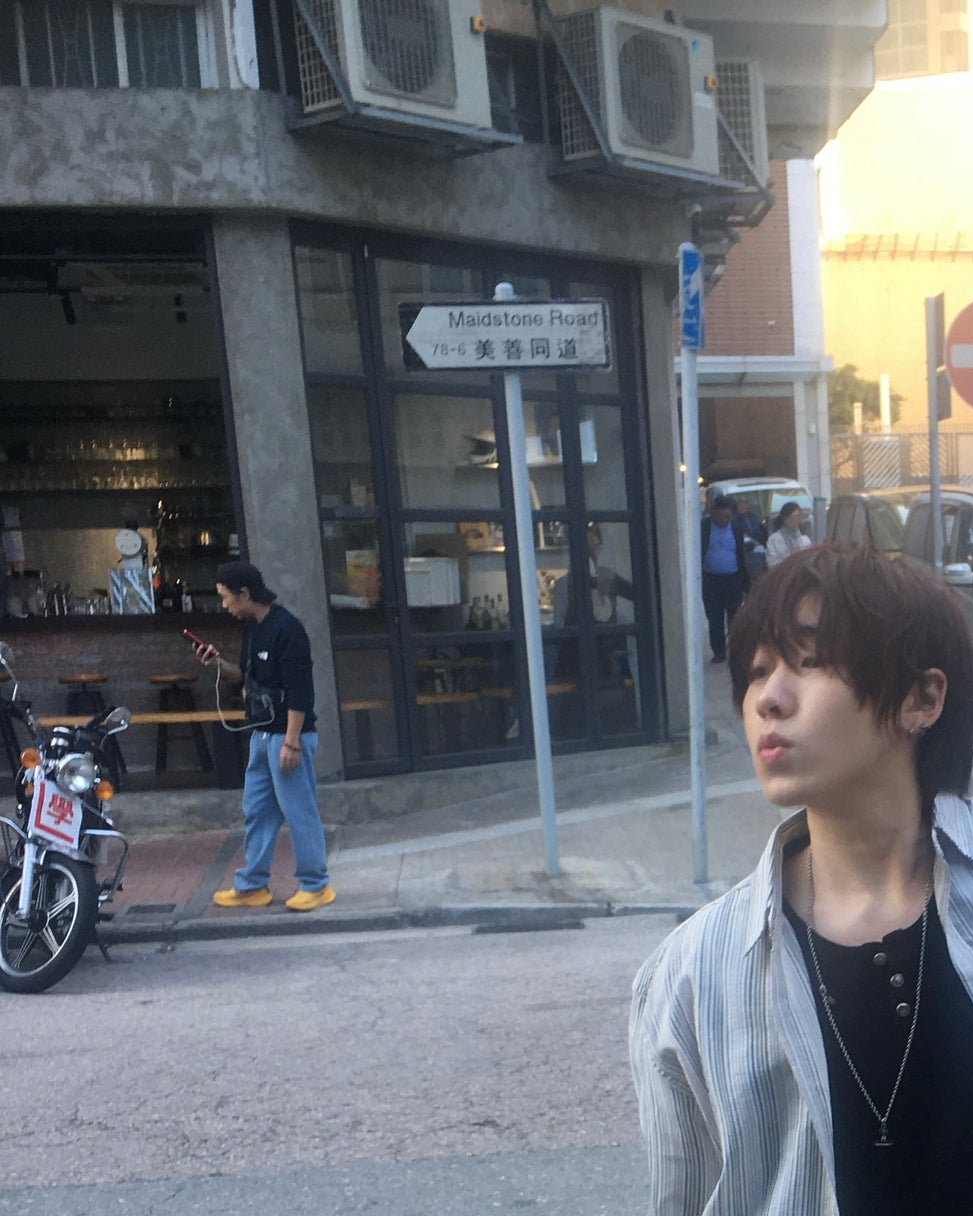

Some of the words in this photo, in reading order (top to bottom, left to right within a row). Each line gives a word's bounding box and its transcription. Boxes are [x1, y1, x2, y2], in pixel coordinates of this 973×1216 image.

[449, 311, 543, 329] Maidstone
[550, 309, 598, 326] Road
[474, 336, 579, 361] 美善同道
[47, 793, 74, 825] 學
